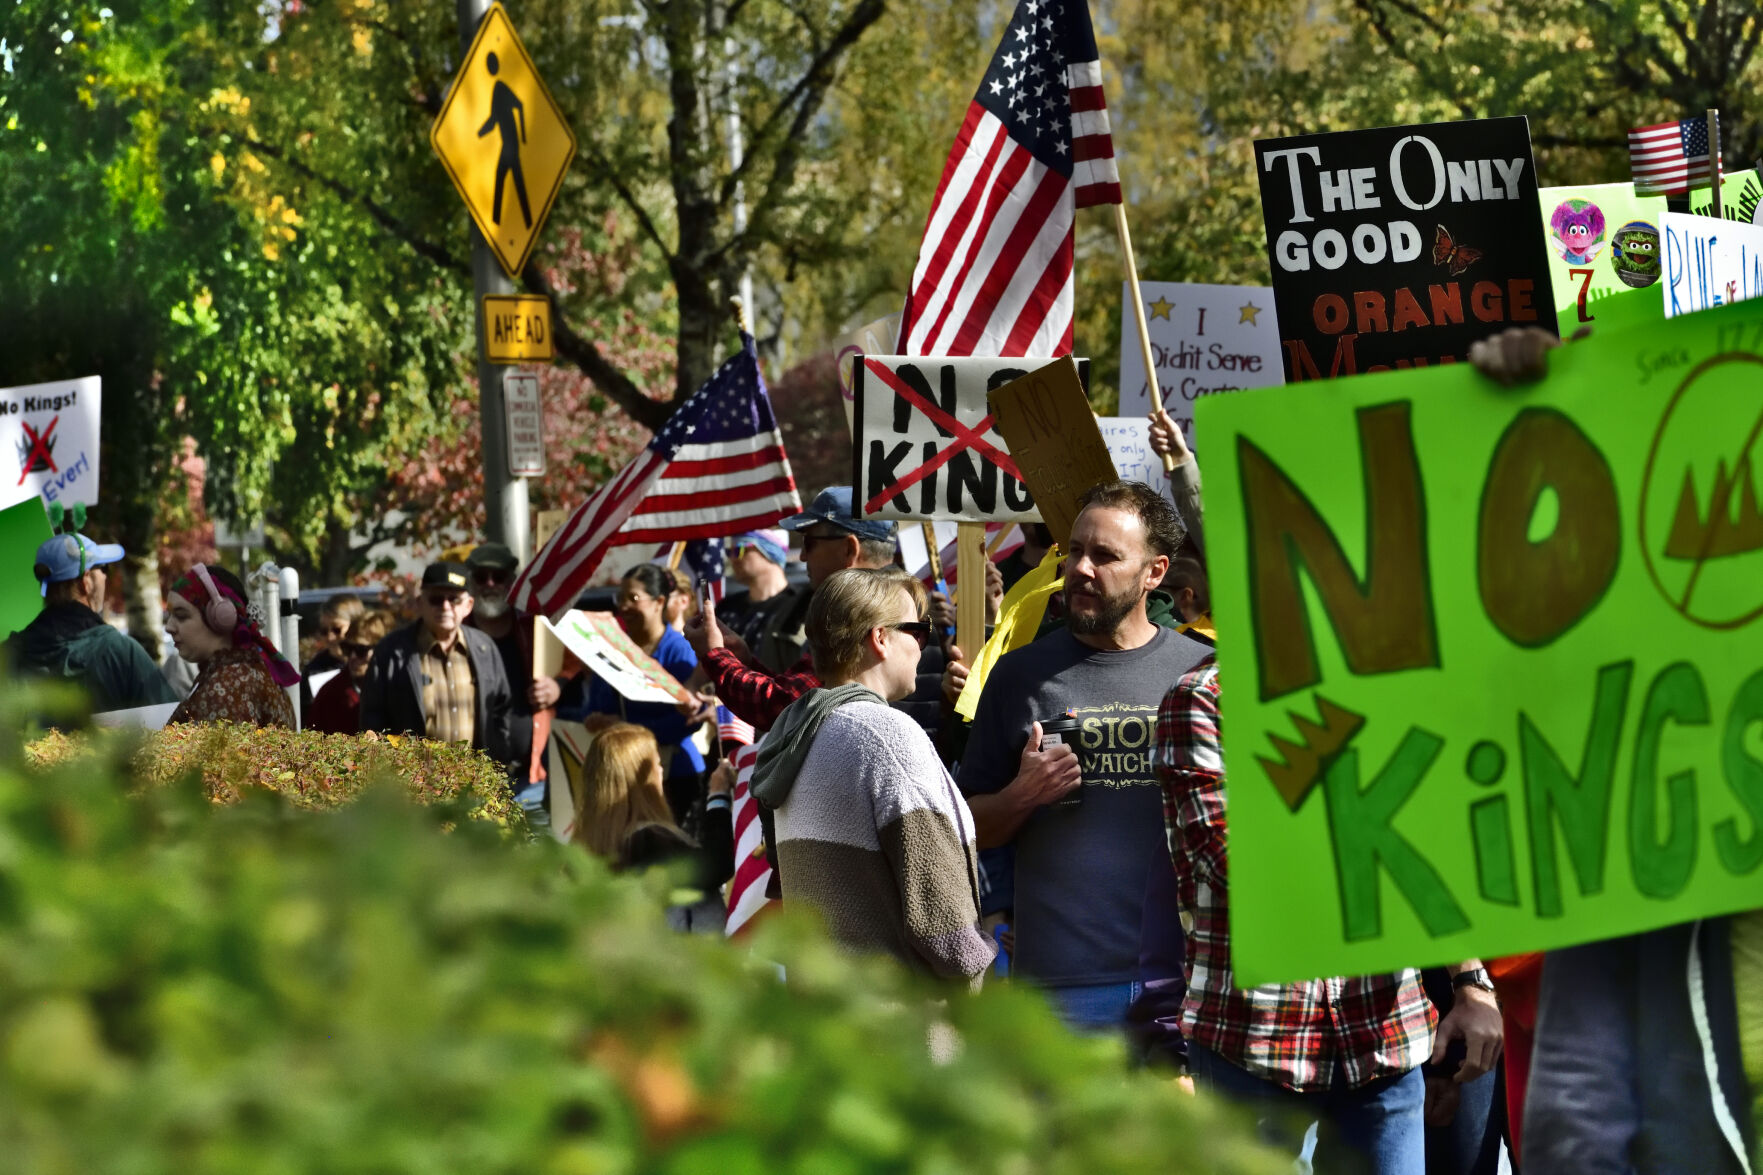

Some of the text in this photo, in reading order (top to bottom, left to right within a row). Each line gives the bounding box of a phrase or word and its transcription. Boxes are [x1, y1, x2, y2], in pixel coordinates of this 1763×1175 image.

[1263, 134, 1525, 224] THE ONLY
[1275, 220, 1422, 272] GOOD
[1197, 308, 1207, 336] I
[1312, 278, 1538, 334] ORANGE
[1569, 269, 1595, 323] 7
[494, 314, 545, 344] AHEAD
[1207, 343, 1263, 373] Serve
[24, 390, 77, 412] Kings!
[1013, 377, 1063, 443] NO
[1121, 442, 1146, 462] only
[1235, 398, 1622, 704] NO
